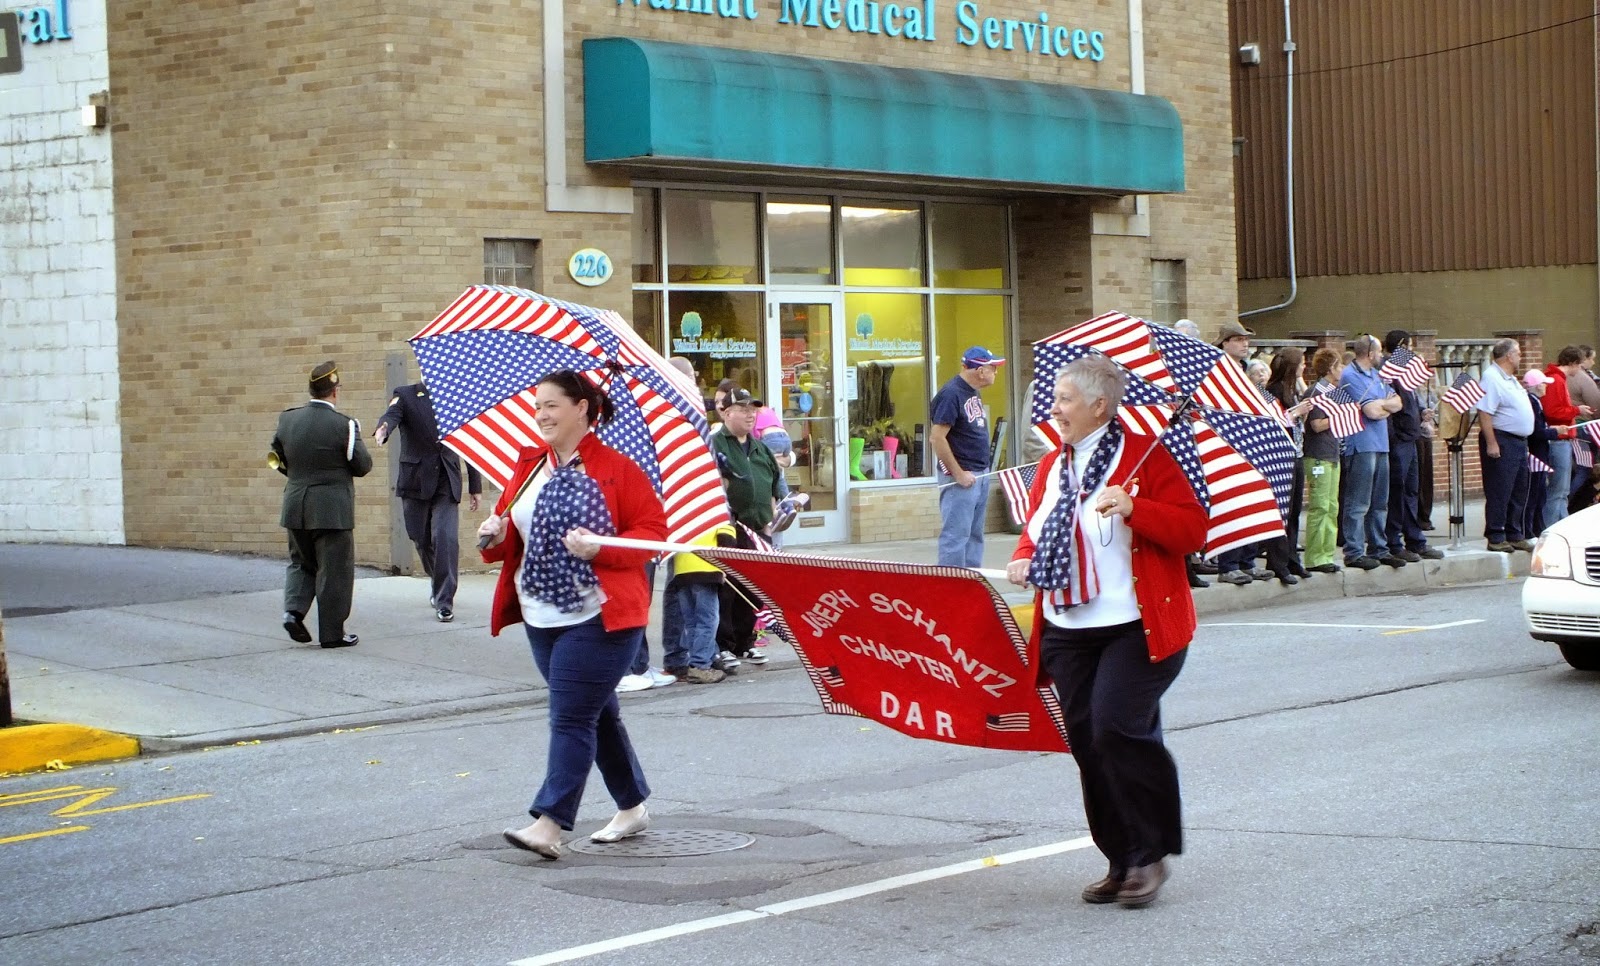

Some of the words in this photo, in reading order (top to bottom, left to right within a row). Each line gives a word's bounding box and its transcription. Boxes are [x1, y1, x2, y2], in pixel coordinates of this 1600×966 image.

[16, 0, 72, 44] al
[777, 0, 936, 42] Medical
[955, 0, 1105, 62] Services
[575, 254, 607, 278] 226
[839, 635, 961, 688] CHAPTER
[869, 593, 1017, 698] SCHANTZ
